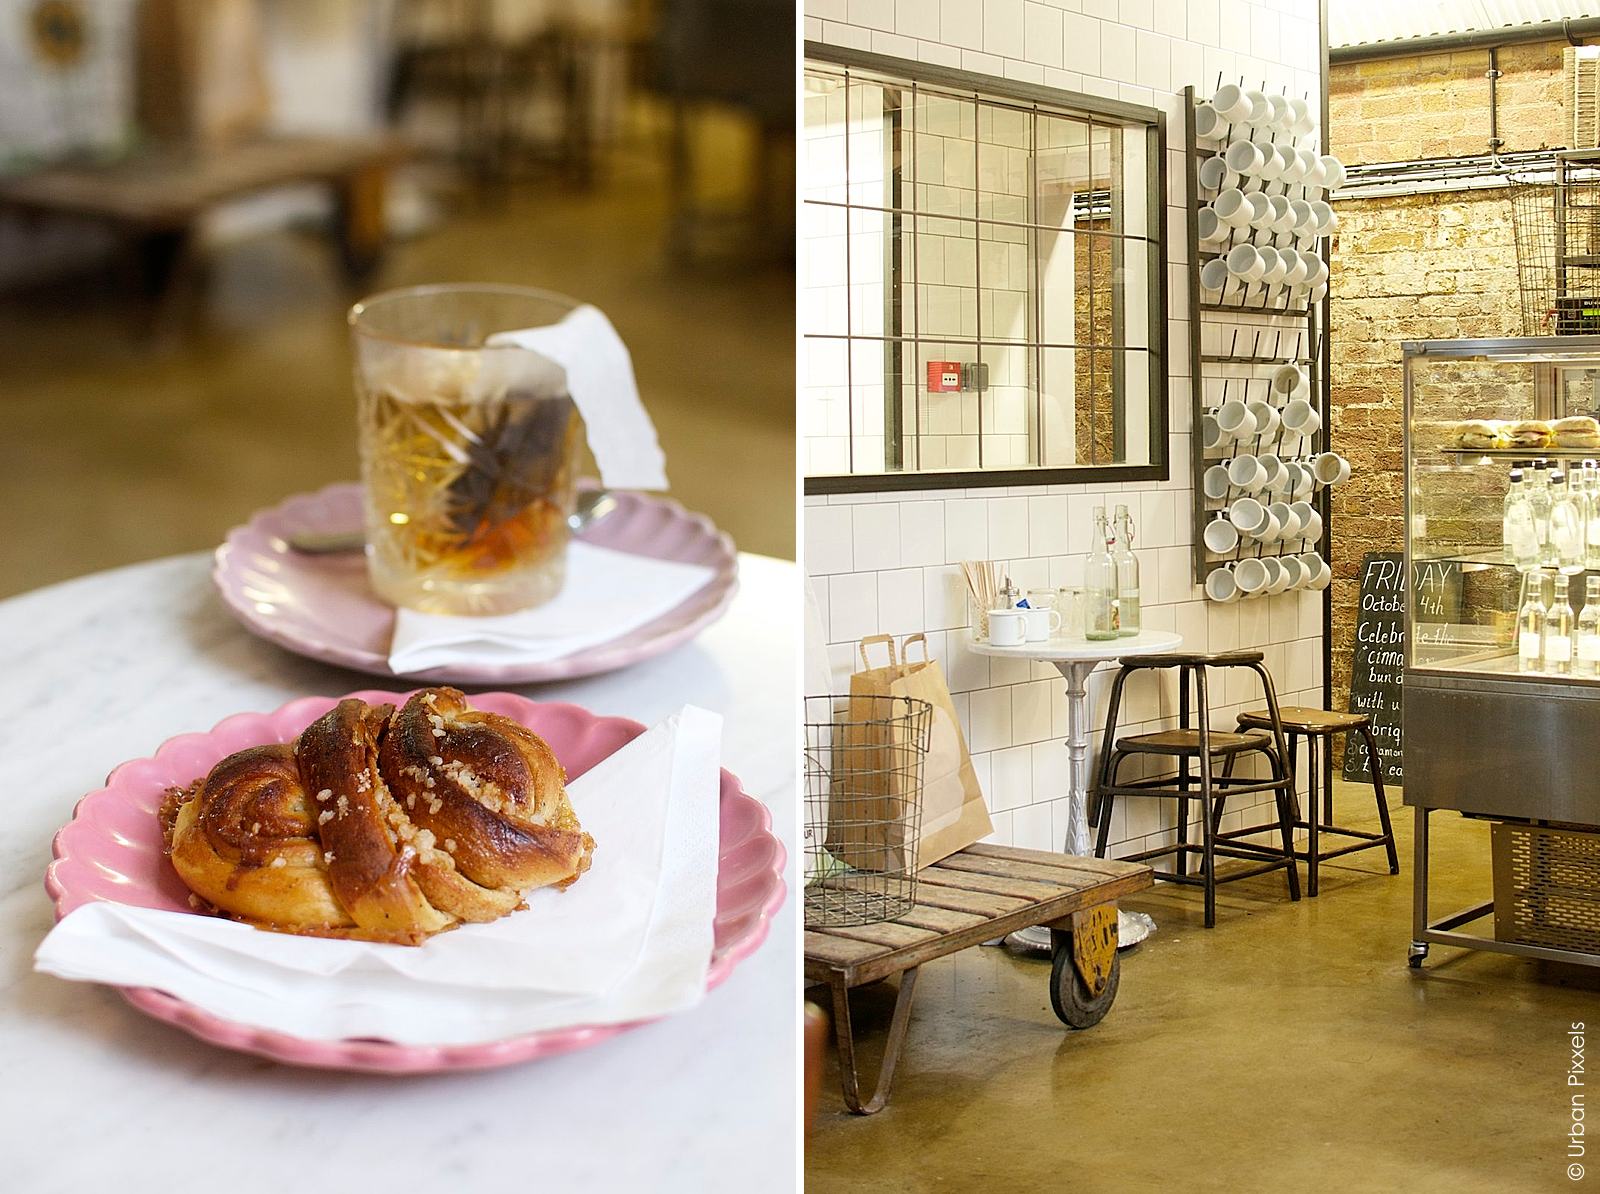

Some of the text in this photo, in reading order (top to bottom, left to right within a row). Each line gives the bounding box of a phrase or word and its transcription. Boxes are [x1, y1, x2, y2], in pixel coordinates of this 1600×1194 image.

[1362, 593, 1445, 615] Octobe 4th
[1368, 666, 1392, 683] bun
[1357, 691, 1384, 709] with
